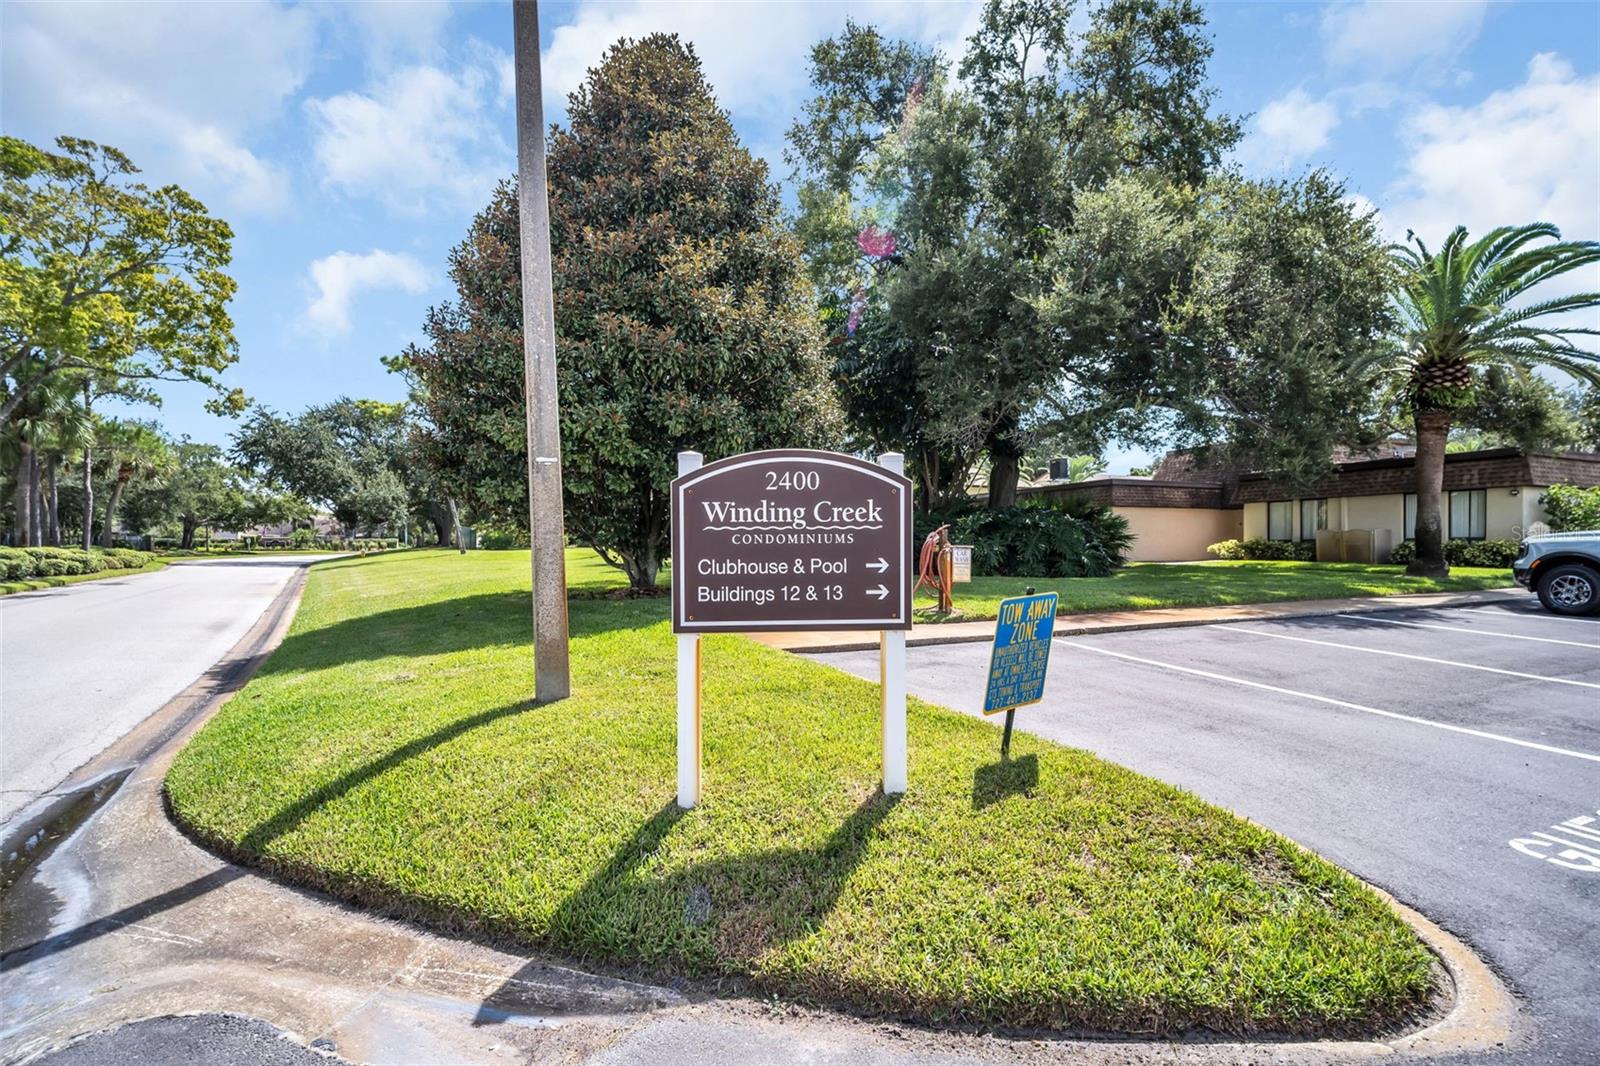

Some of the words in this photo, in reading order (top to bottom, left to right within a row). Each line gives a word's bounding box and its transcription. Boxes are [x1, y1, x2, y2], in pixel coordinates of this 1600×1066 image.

[765, 471, 820, 491] 2400
[702, 500, 806, 530] Winding
[813, 499, 883, 523] Creek
[732, 533, 854, 545] CONDOMINIUMS
[698, 558, 788, 575] Clubhouse
[793, 559, 805, 575] &
[810, 558, 848, 574] Pool
[698, 586, 775, 605] Buildings
[781, 586, 800, 601] 12
[806, 586, 818, 601] &
[824, 585, 843, 601] 13
[1001, 602, 1024, 626] TOW
[1027, 597, 1055, 621] AWAY
[1009, 620, 1039, 645] ZONE
